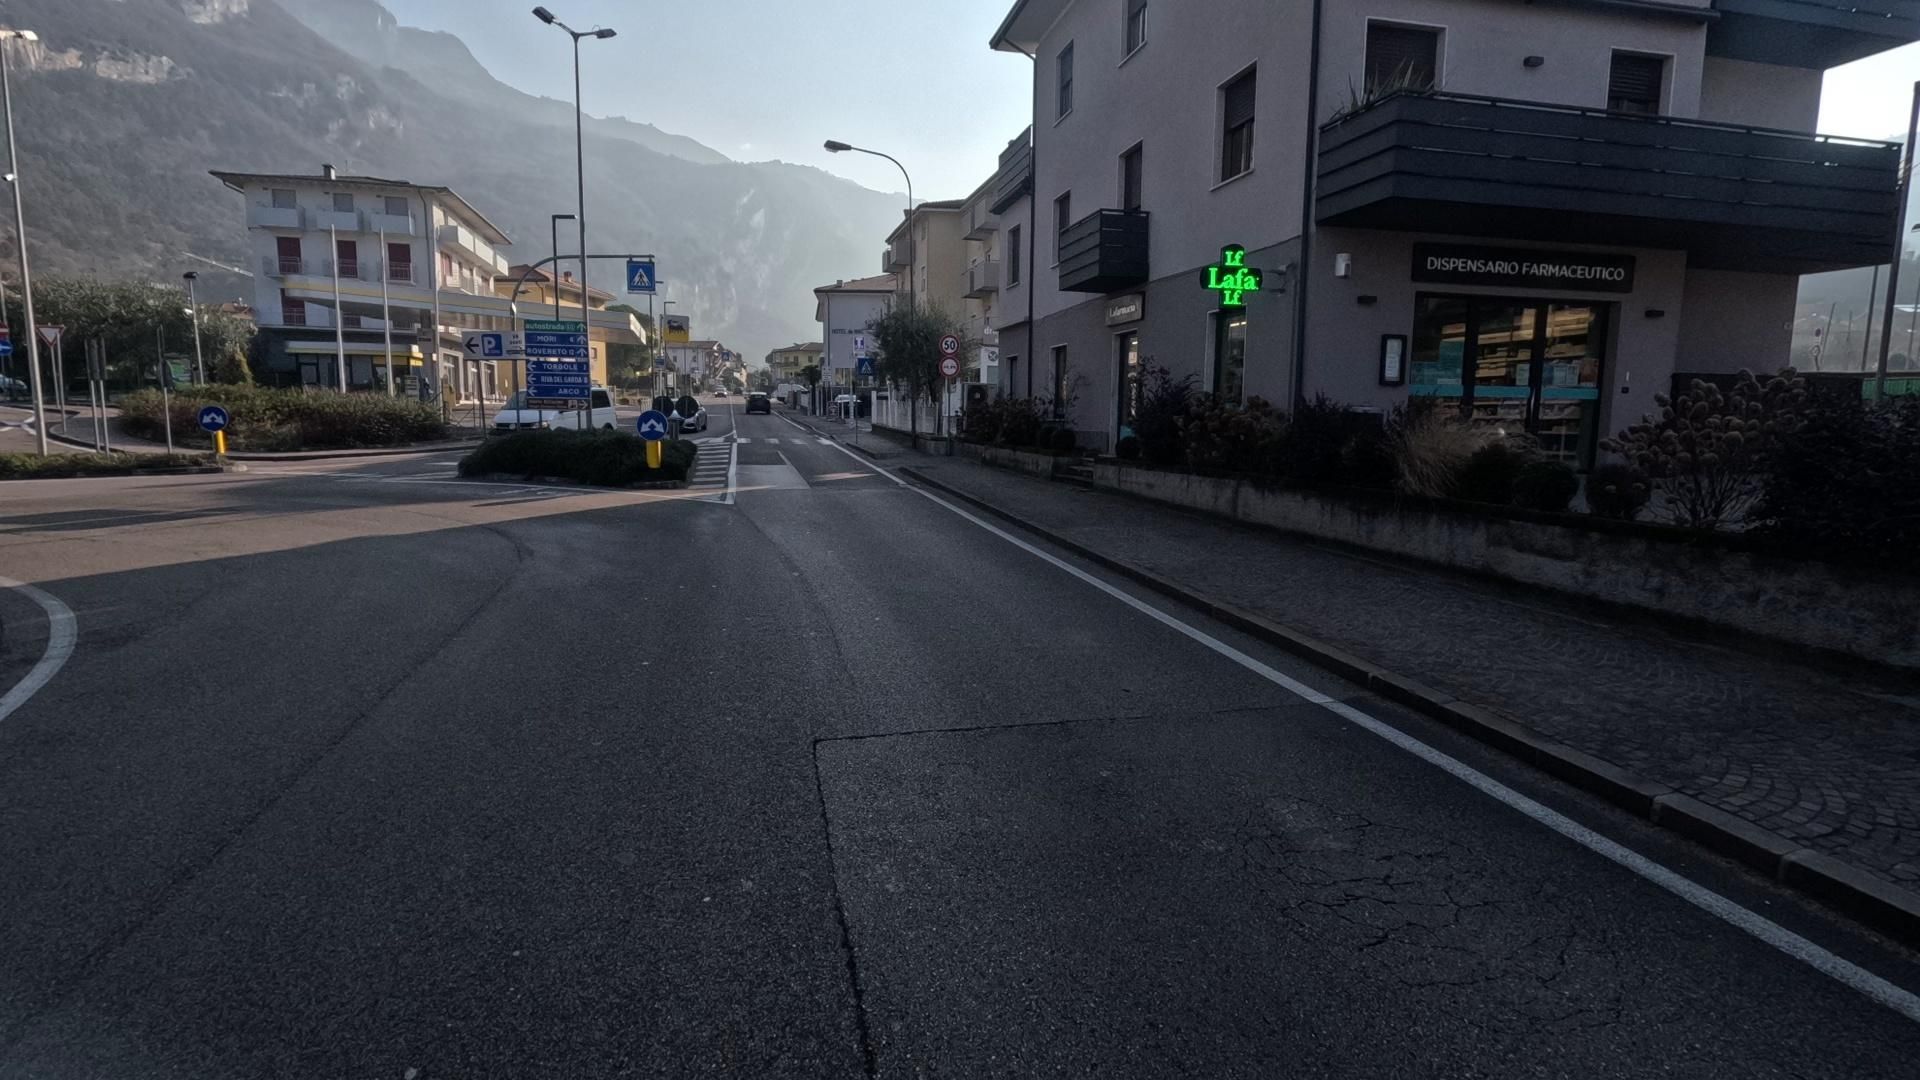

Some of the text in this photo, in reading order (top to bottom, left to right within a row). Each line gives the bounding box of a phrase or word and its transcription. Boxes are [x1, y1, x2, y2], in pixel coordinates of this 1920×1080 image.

[1225, 250, 1244, 266] Lf
[1427, 256, 1625, 281] DISPENSARIO FARMACEUTICO
[1208, 268, 1259, 290] Lafa
[1223, 290, 1242, 305] Lf
[526, 322, 564, 330] autostrada
[536, 335, 557, 343] MORI
[944, 340, 956, 350] 50
[527, 347, 568, 355] ROVERETO
[540, 375, 553, 383] RIVA
